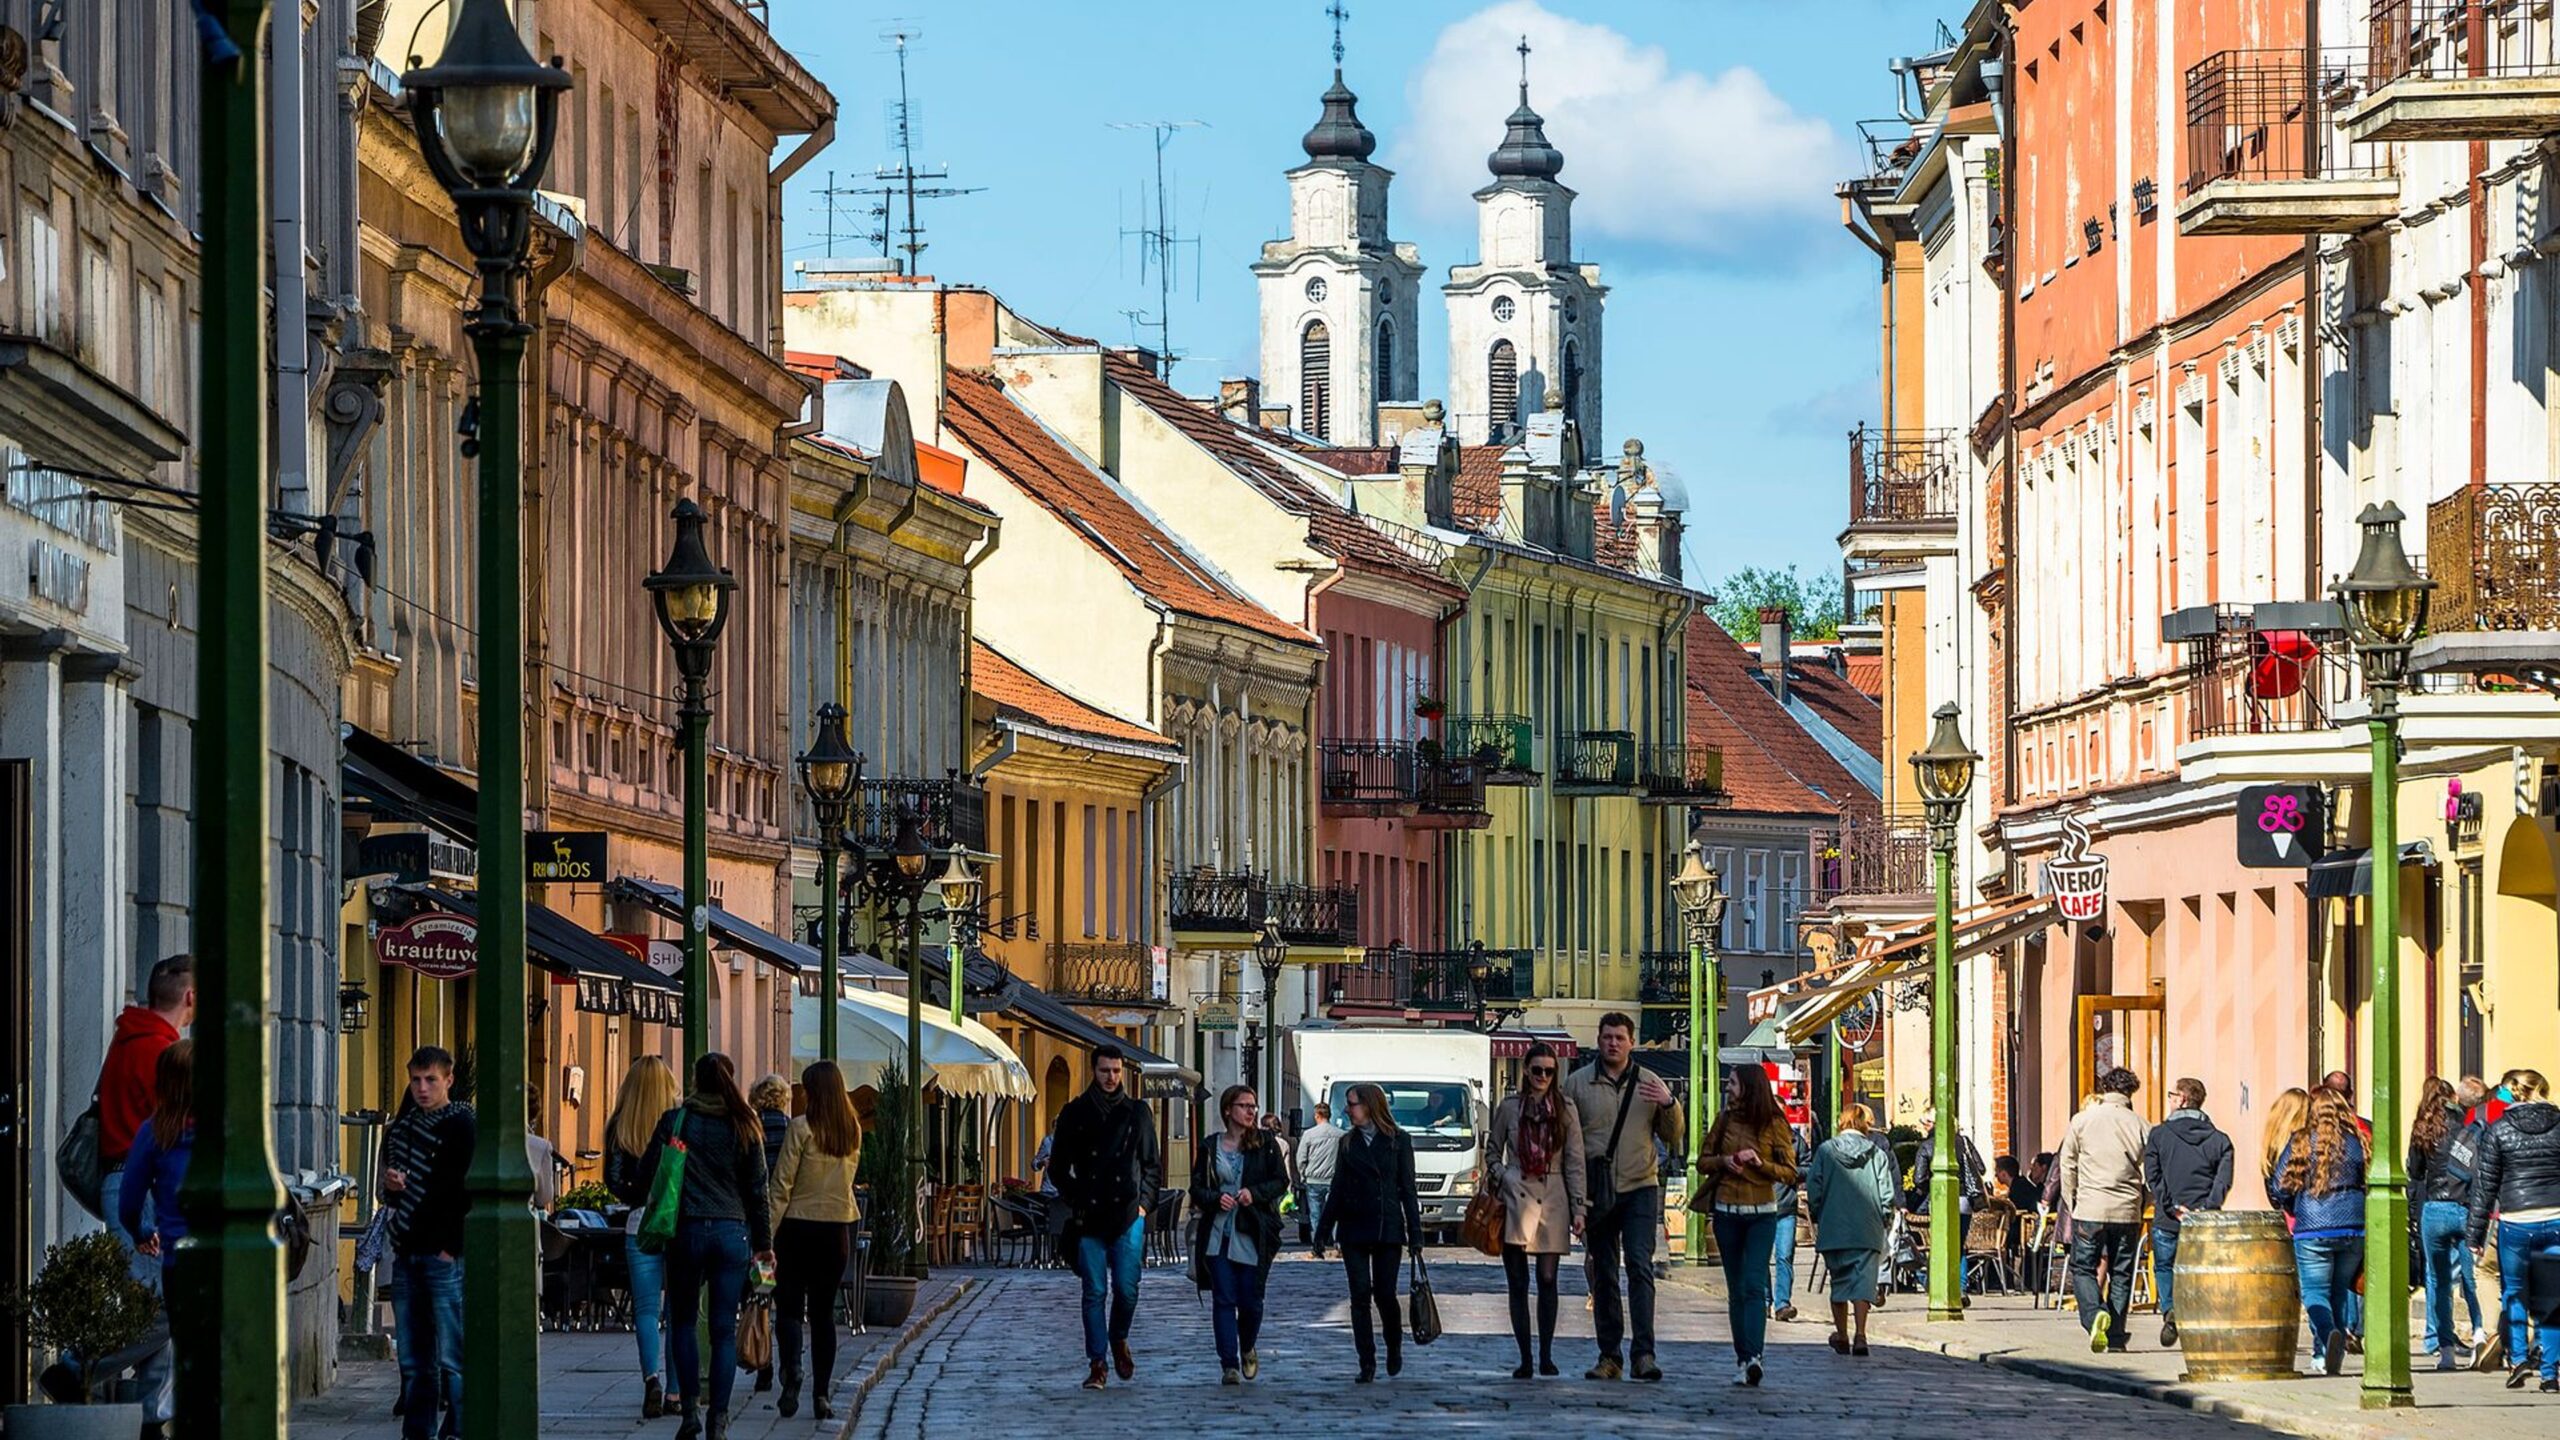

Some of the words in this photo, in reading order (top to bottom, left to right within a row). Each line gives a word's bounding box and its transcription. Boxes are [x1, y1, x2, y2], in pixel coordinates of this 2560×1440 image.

[533, 862, 591, 878] RHODOS
[2052, 868, 2103, 892] VERO
[2060, 892, 2101, 916] CAFE
